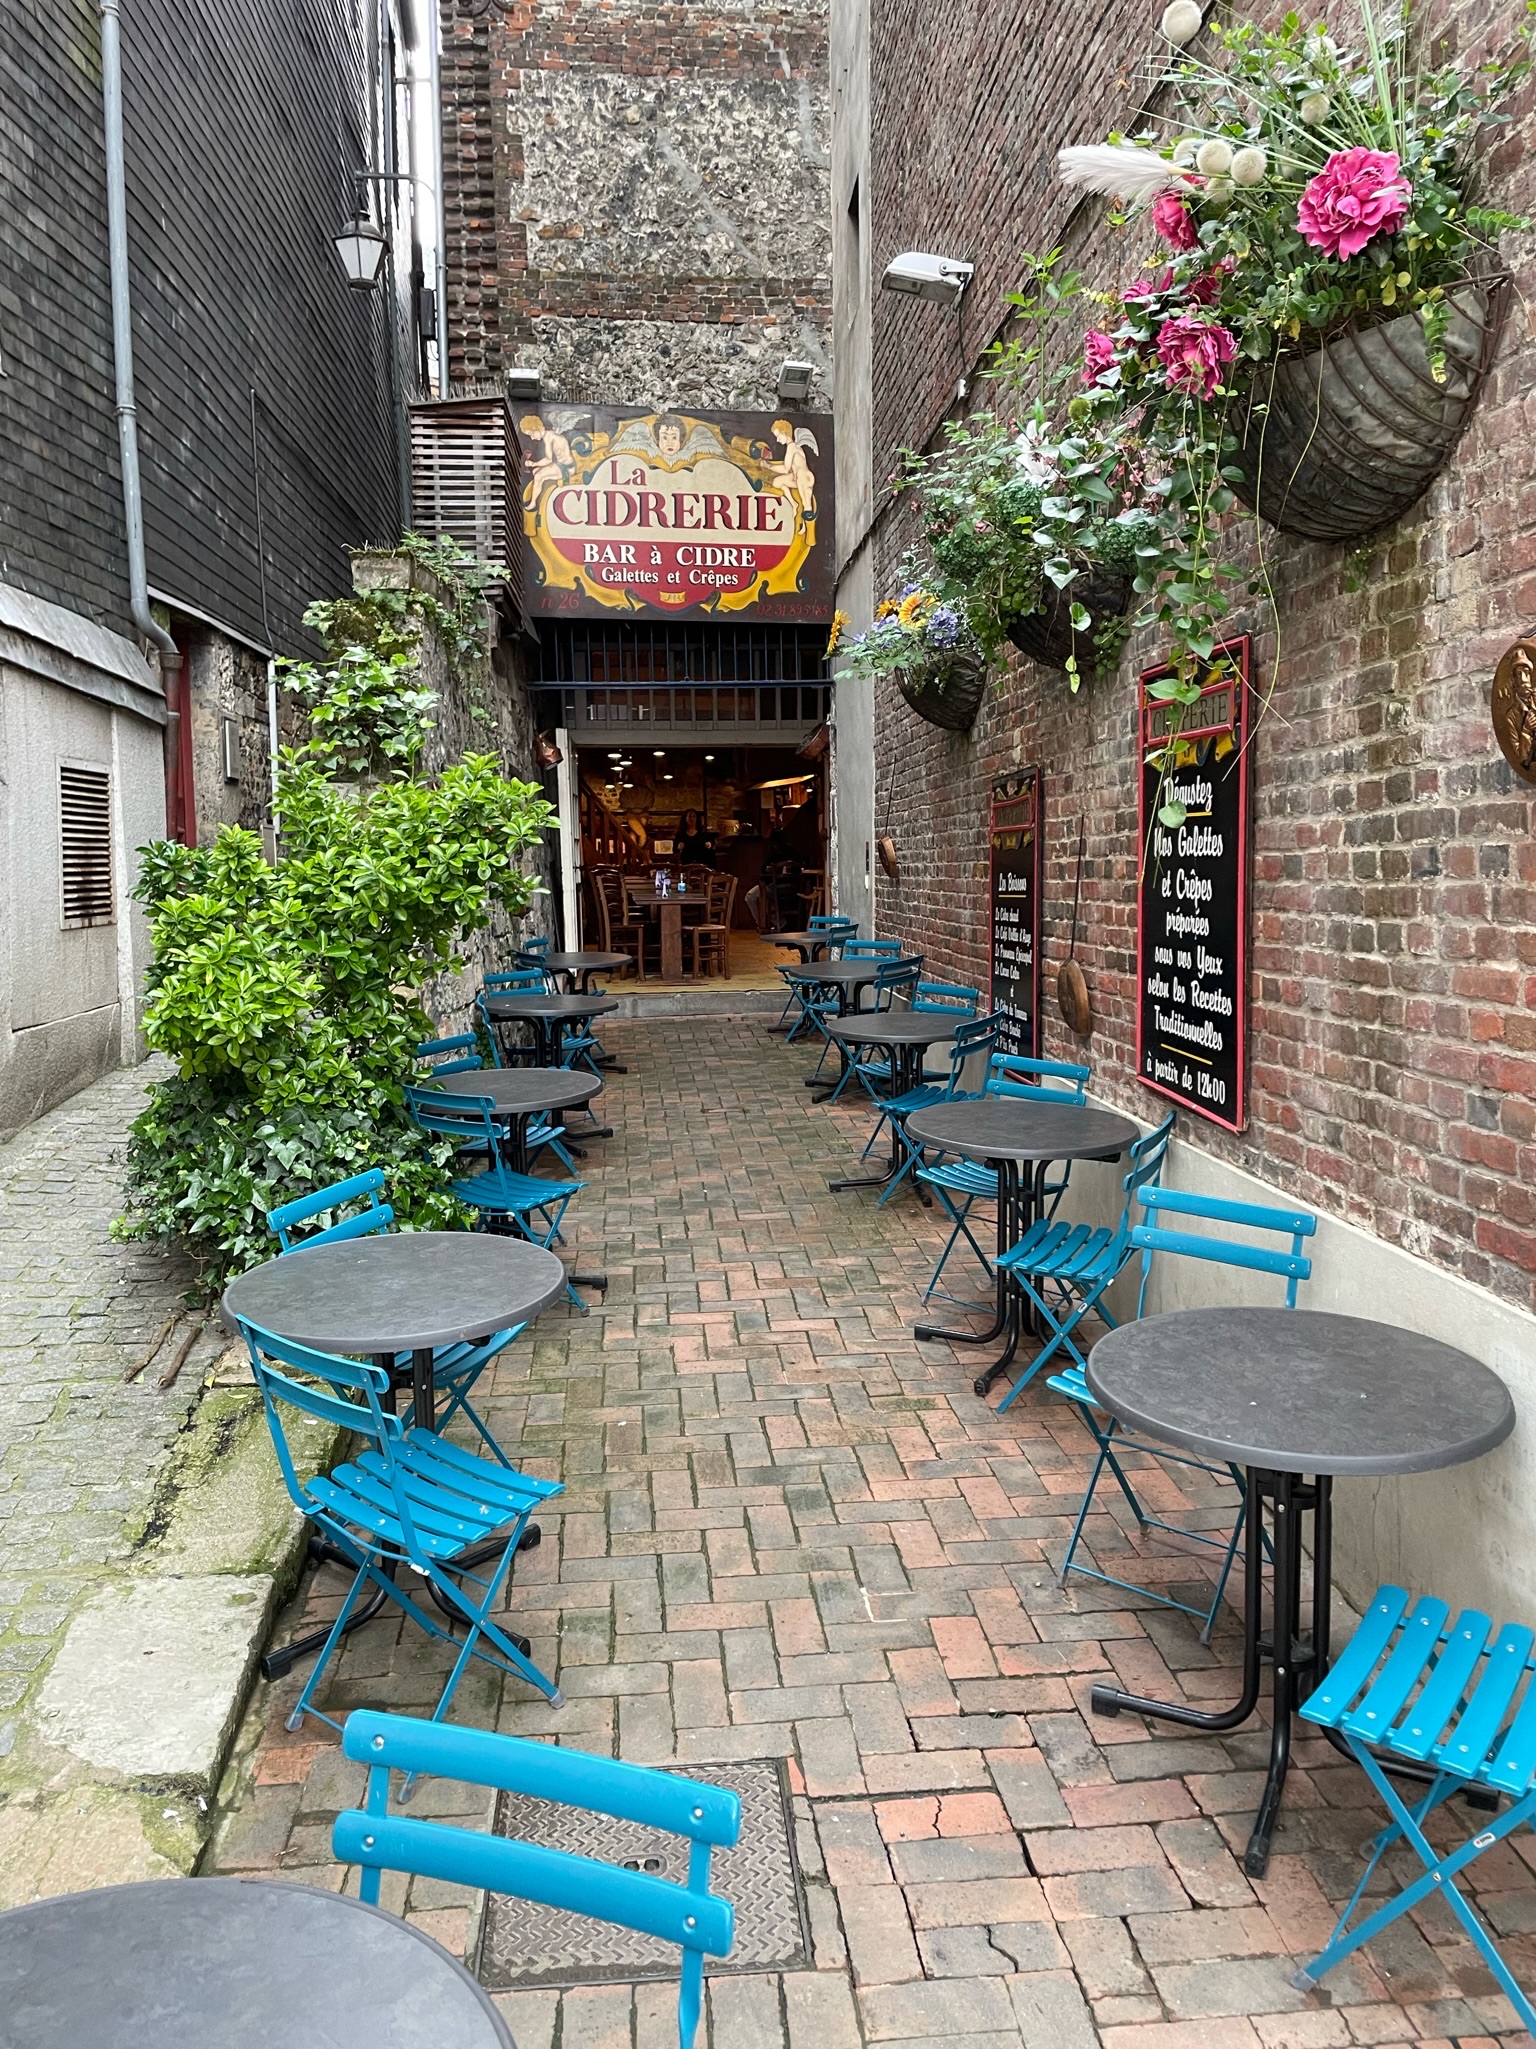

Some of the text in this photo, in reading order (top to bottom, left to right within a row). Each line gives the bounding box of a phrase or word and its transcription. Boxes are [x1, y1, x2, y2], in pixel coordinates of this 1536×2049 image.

[610, 460, 647, 487] La
[553, 489, 783, 532] CIDRERIE
[584, 543, 756, 567] BAR à CIDRE
[601, 567, 739, 588] Galettes et Crêpes
[558, 592, 580, 609] 26
[1154, 825, 1223, 857] Nos Galettes
[1162, 868, 1213, 907] et Crêpes
[1166, 907, 1210, 940] préparées
[1155, 945, 1223, 979] sous vos Yeux
[1148, 973, 1233, 1017] selon les Recettes
[1154, 1005, 1223, 1051] Traditionnelles
[1147, 1051, 1226, 1105] à partir de 12h00
